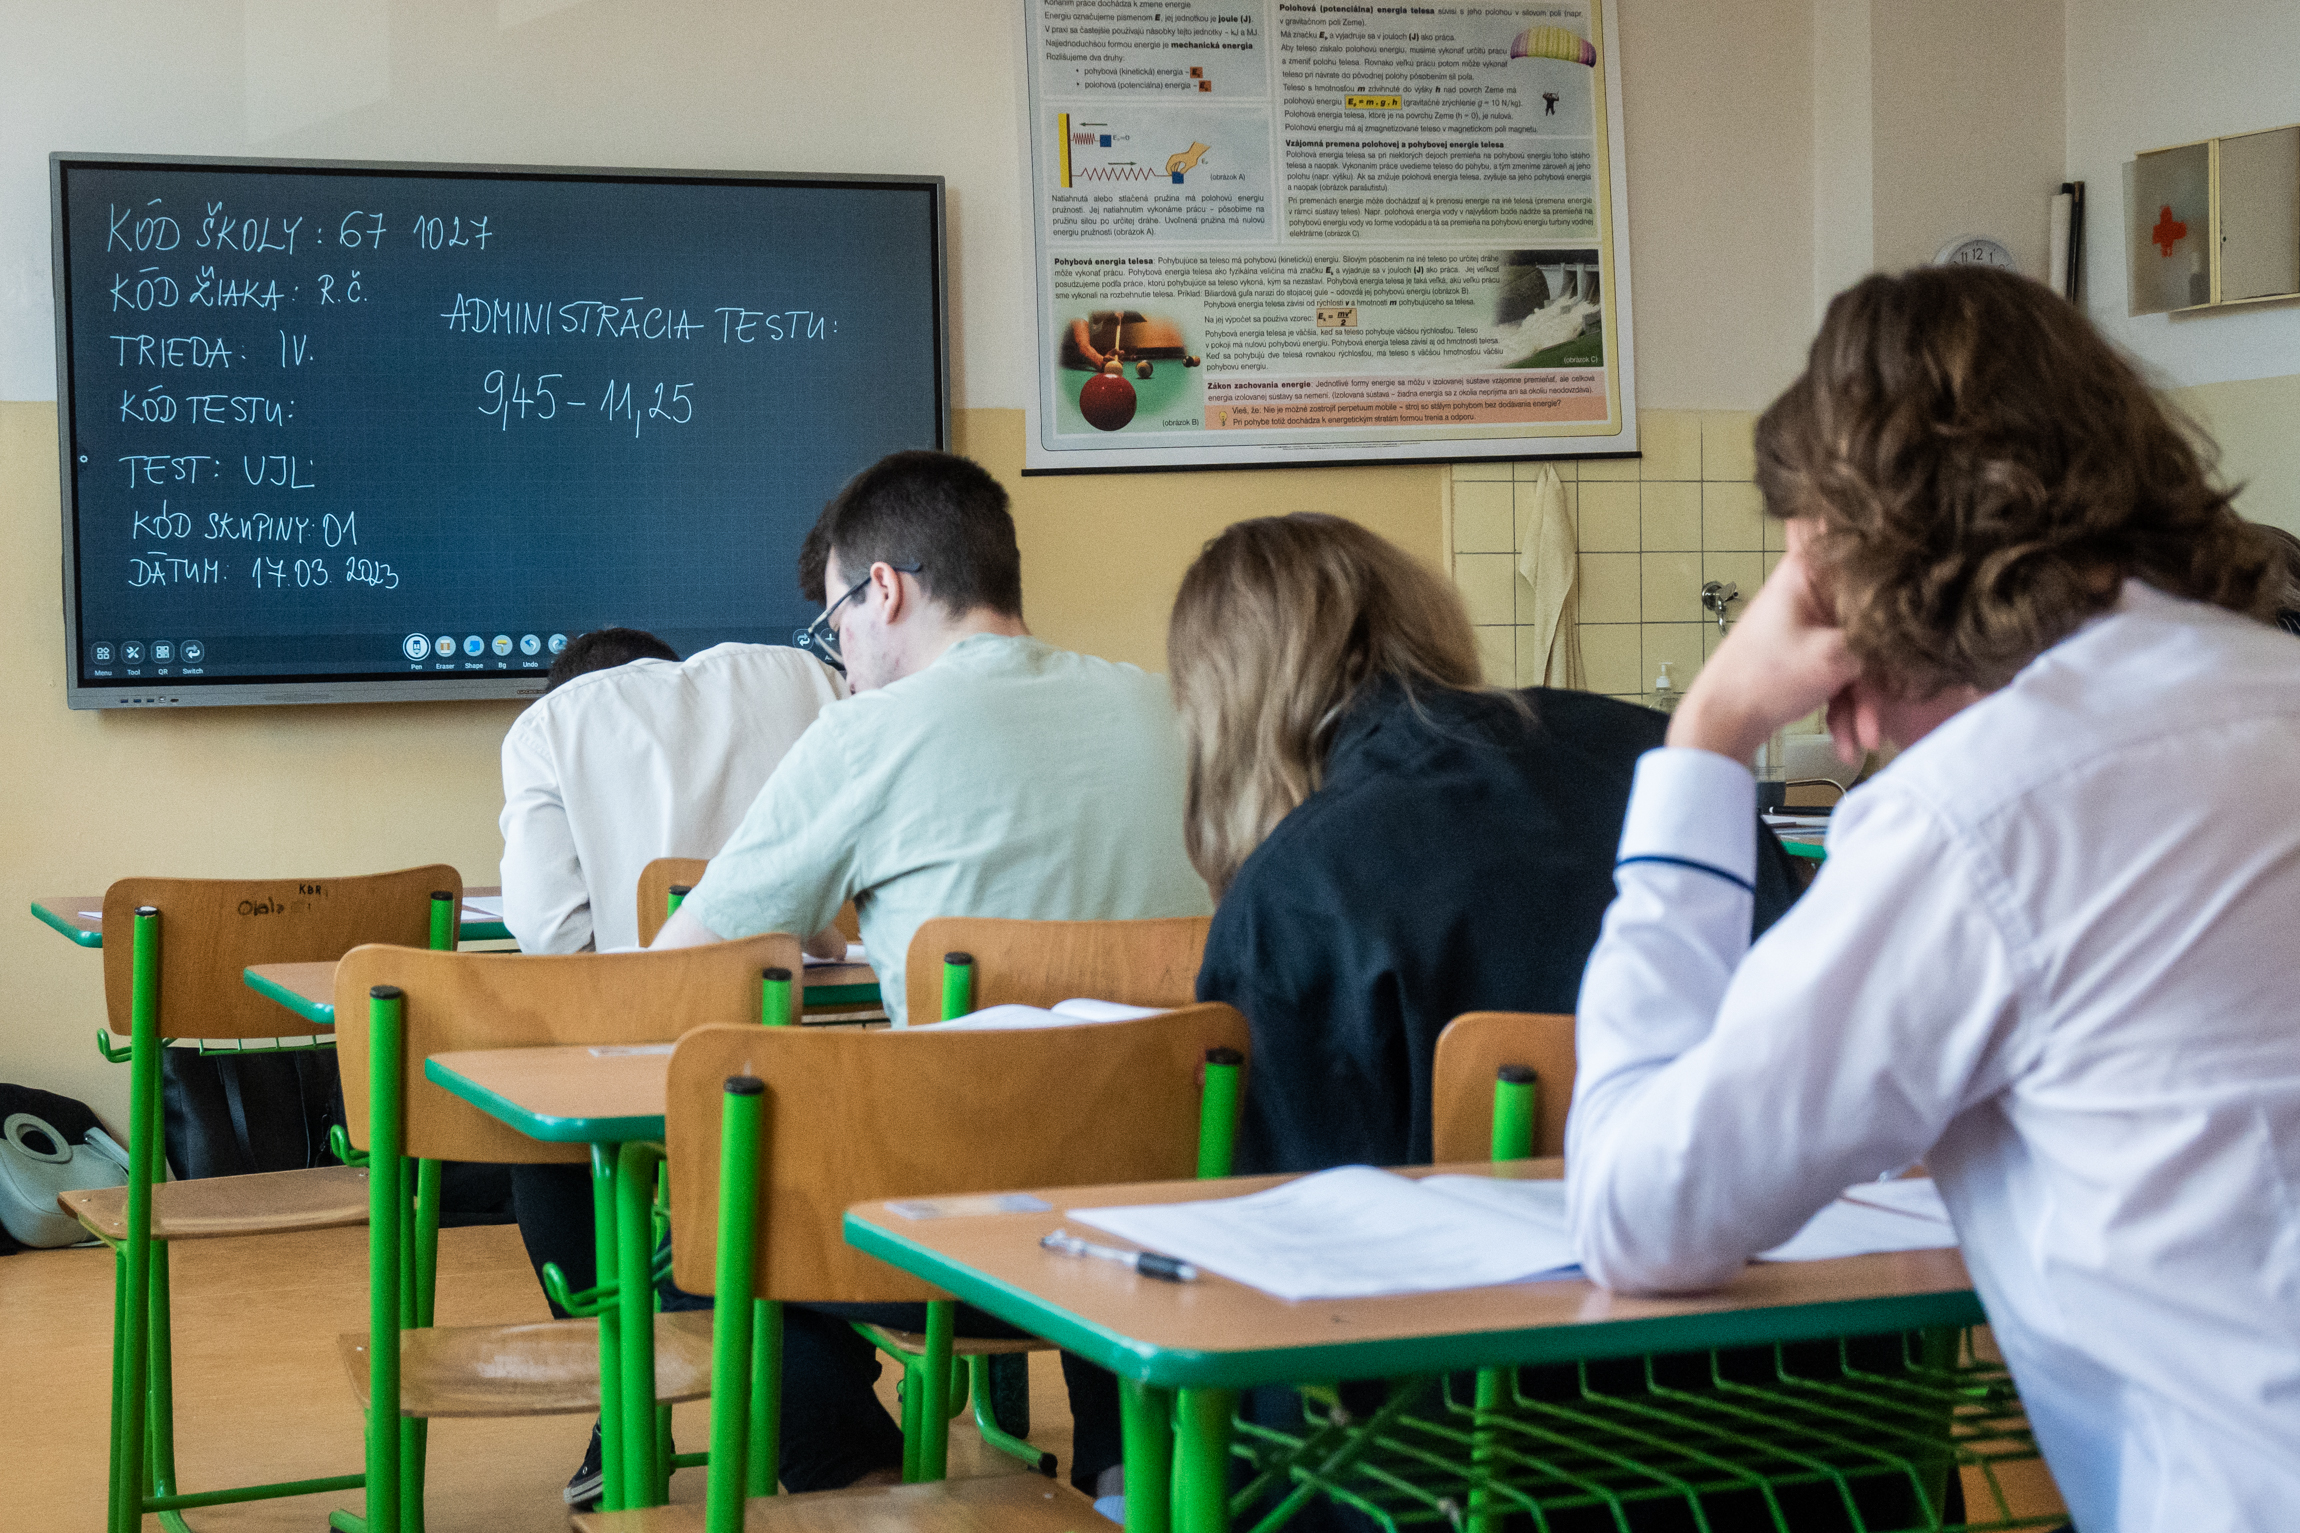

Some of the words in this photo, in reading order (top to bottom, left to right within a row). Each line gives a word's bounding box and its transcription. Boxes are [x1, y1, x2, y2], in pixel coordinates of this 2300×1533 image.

[339, 210, 387, 249] 67
[413, 215, 493, 249] 1027
[1961, 252, 1968, 263] 11
[1972, 248, 1983, 260] 12
[119, 455, 219, 488] TEST:
